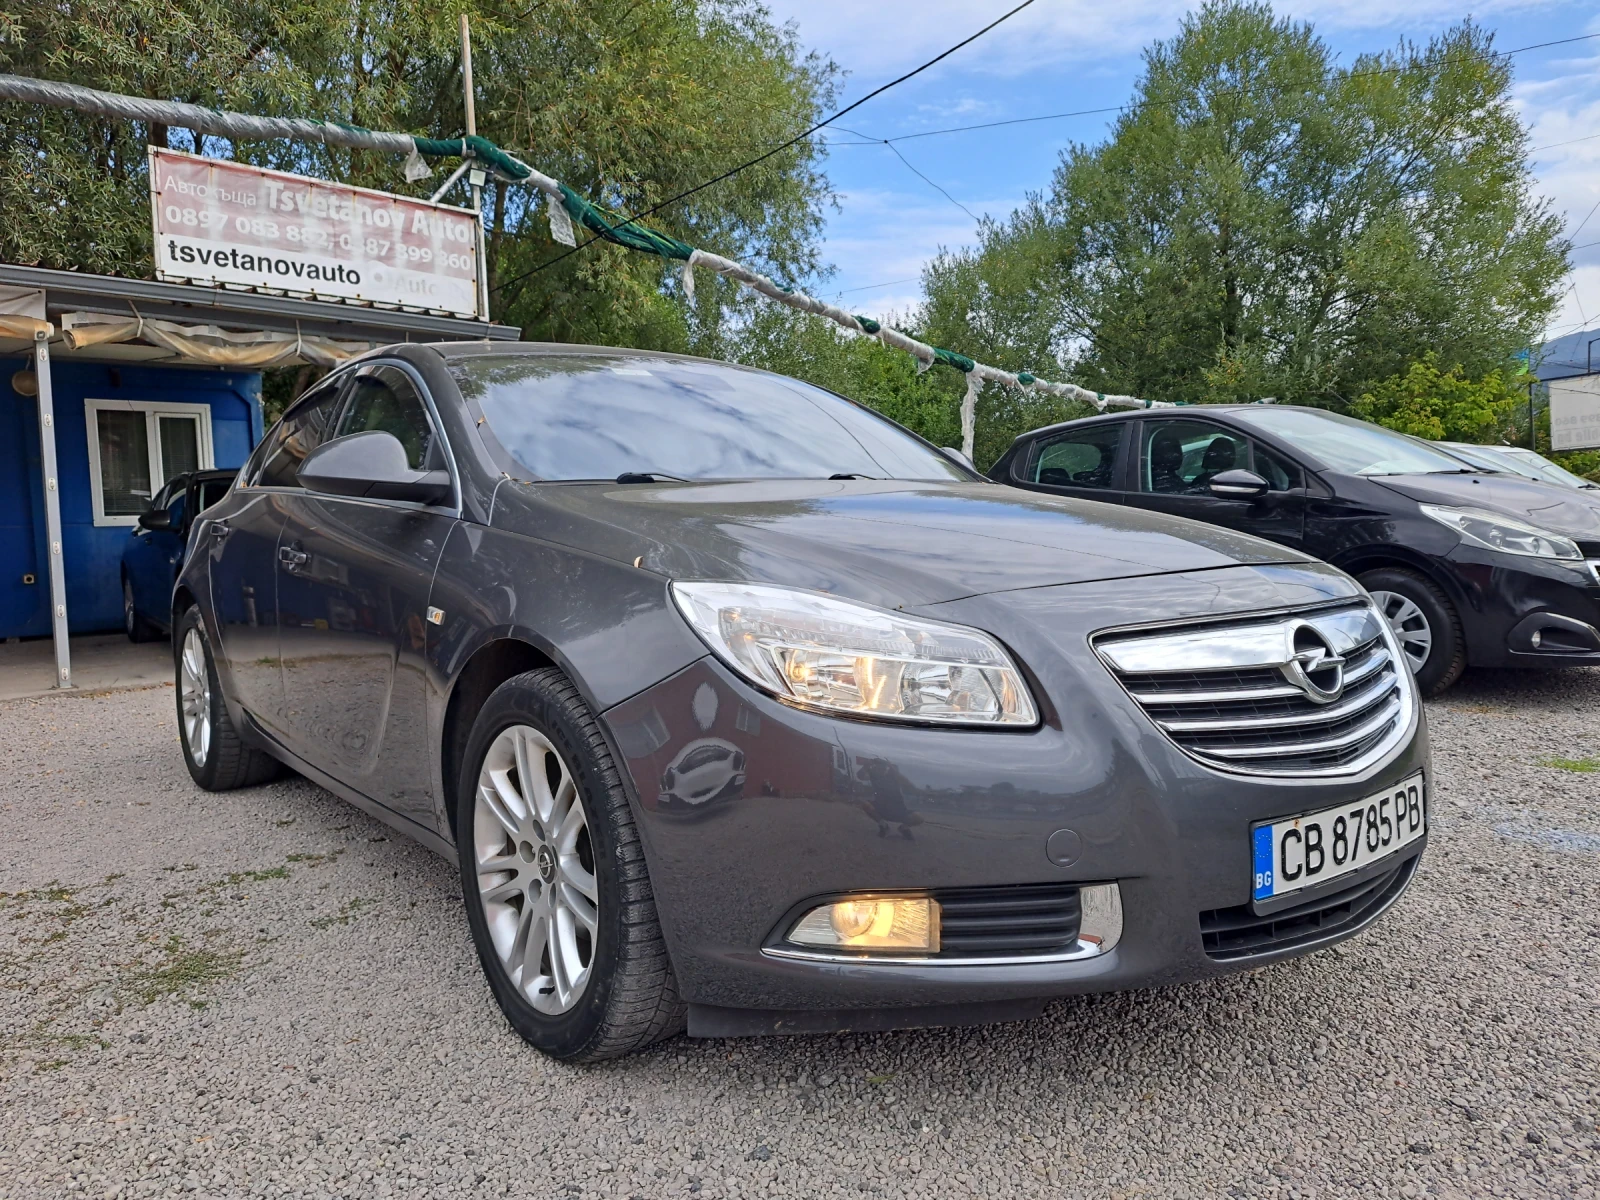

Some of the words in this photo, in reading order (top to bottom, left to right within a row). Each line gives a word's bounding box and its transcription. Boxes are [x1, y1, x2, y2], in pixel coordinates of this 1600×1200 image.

[165, 205, 229, 231] 0897
[235, 216, 280, 239] 083
[339, 233, 391, 257] 087
[265, 179, 405, 231] Tsvetanov
[411, 209, 470, 243] Auto
[168, 239, 361, 285] tsvetanovauto
[1281, 822, 1325, 882] CB
[1332, 796, 1393, 866] 8785
[1395, 784, 1421, 840] PB
[1255, 870, 1272, 889] BG
